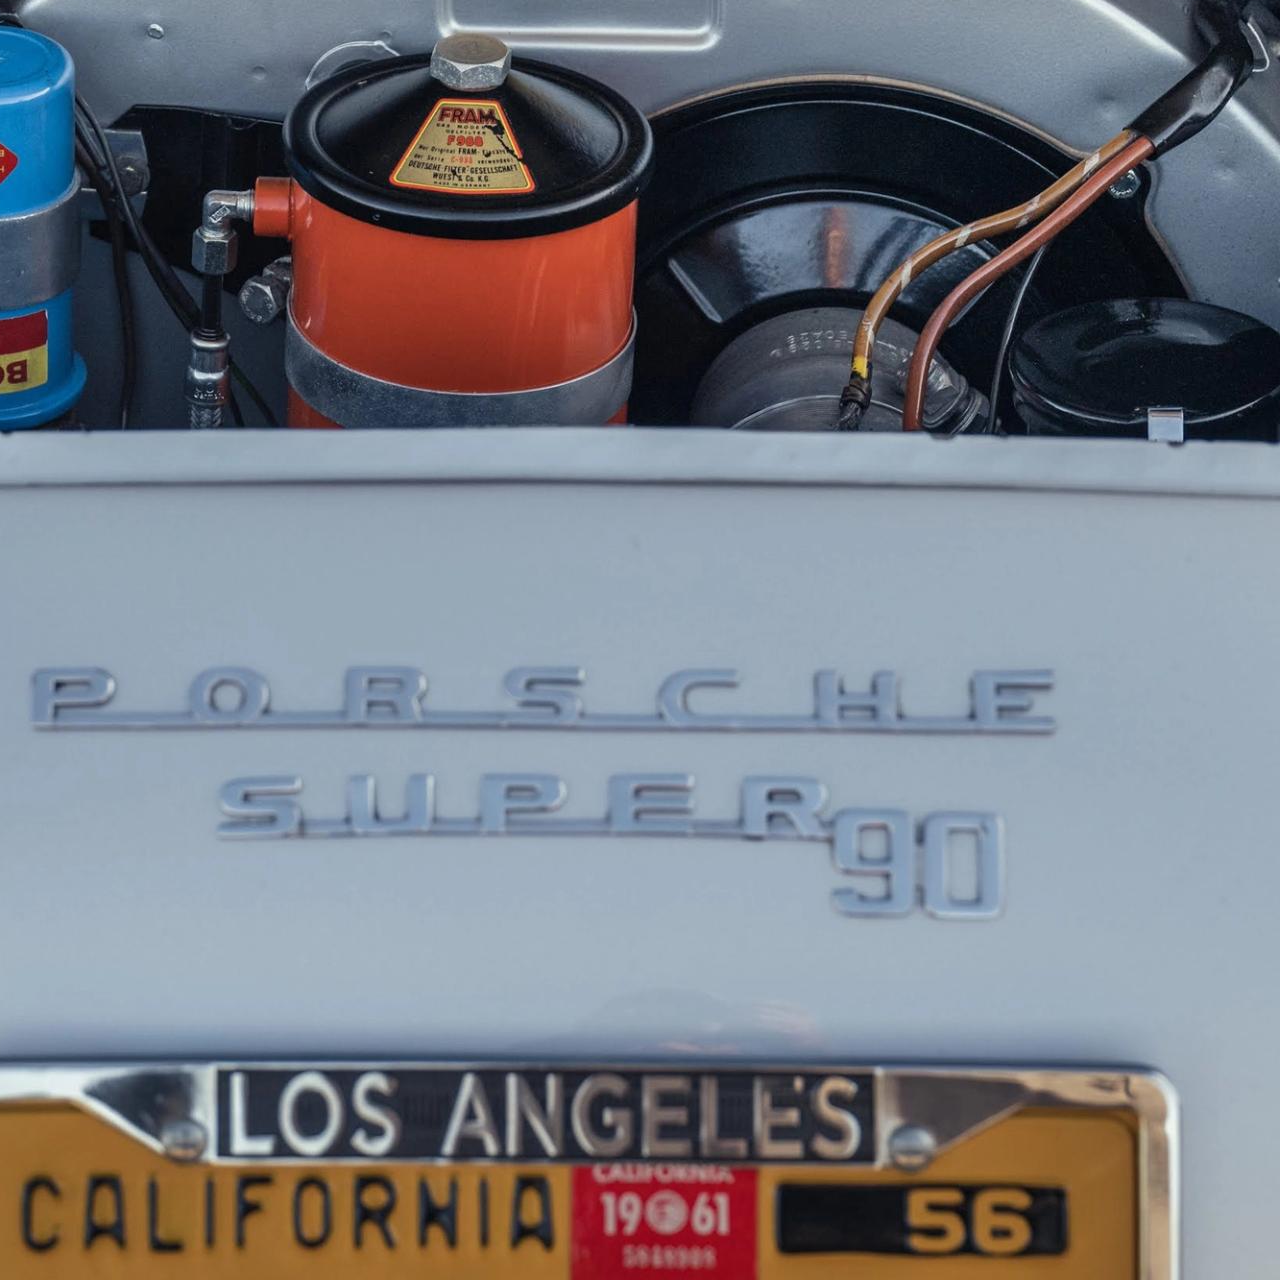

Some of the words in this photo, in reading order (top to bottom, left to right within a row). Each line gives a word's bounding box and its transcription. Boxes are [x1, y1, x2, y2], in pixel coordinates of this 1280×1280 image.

[437, 106, 498, 125] FRAM
[30, 665, 1057, 734] PORSCHE
[217, 773, 834, 842] SUPER
[830, 806, 1006, 920] 90
[229, 1071, 402, 1158] LOS
[440, 1071, 863, 1160] ANGELES
[591, 1163, 736, 1184] CALIFORNIA
[21, 1171, 556, 1253] CALIFORNIA
[599, 1190, 644, 1238] 19
[690, 1191, 731, 1238] 61
[906, 1186, 1034, 1257] 56
